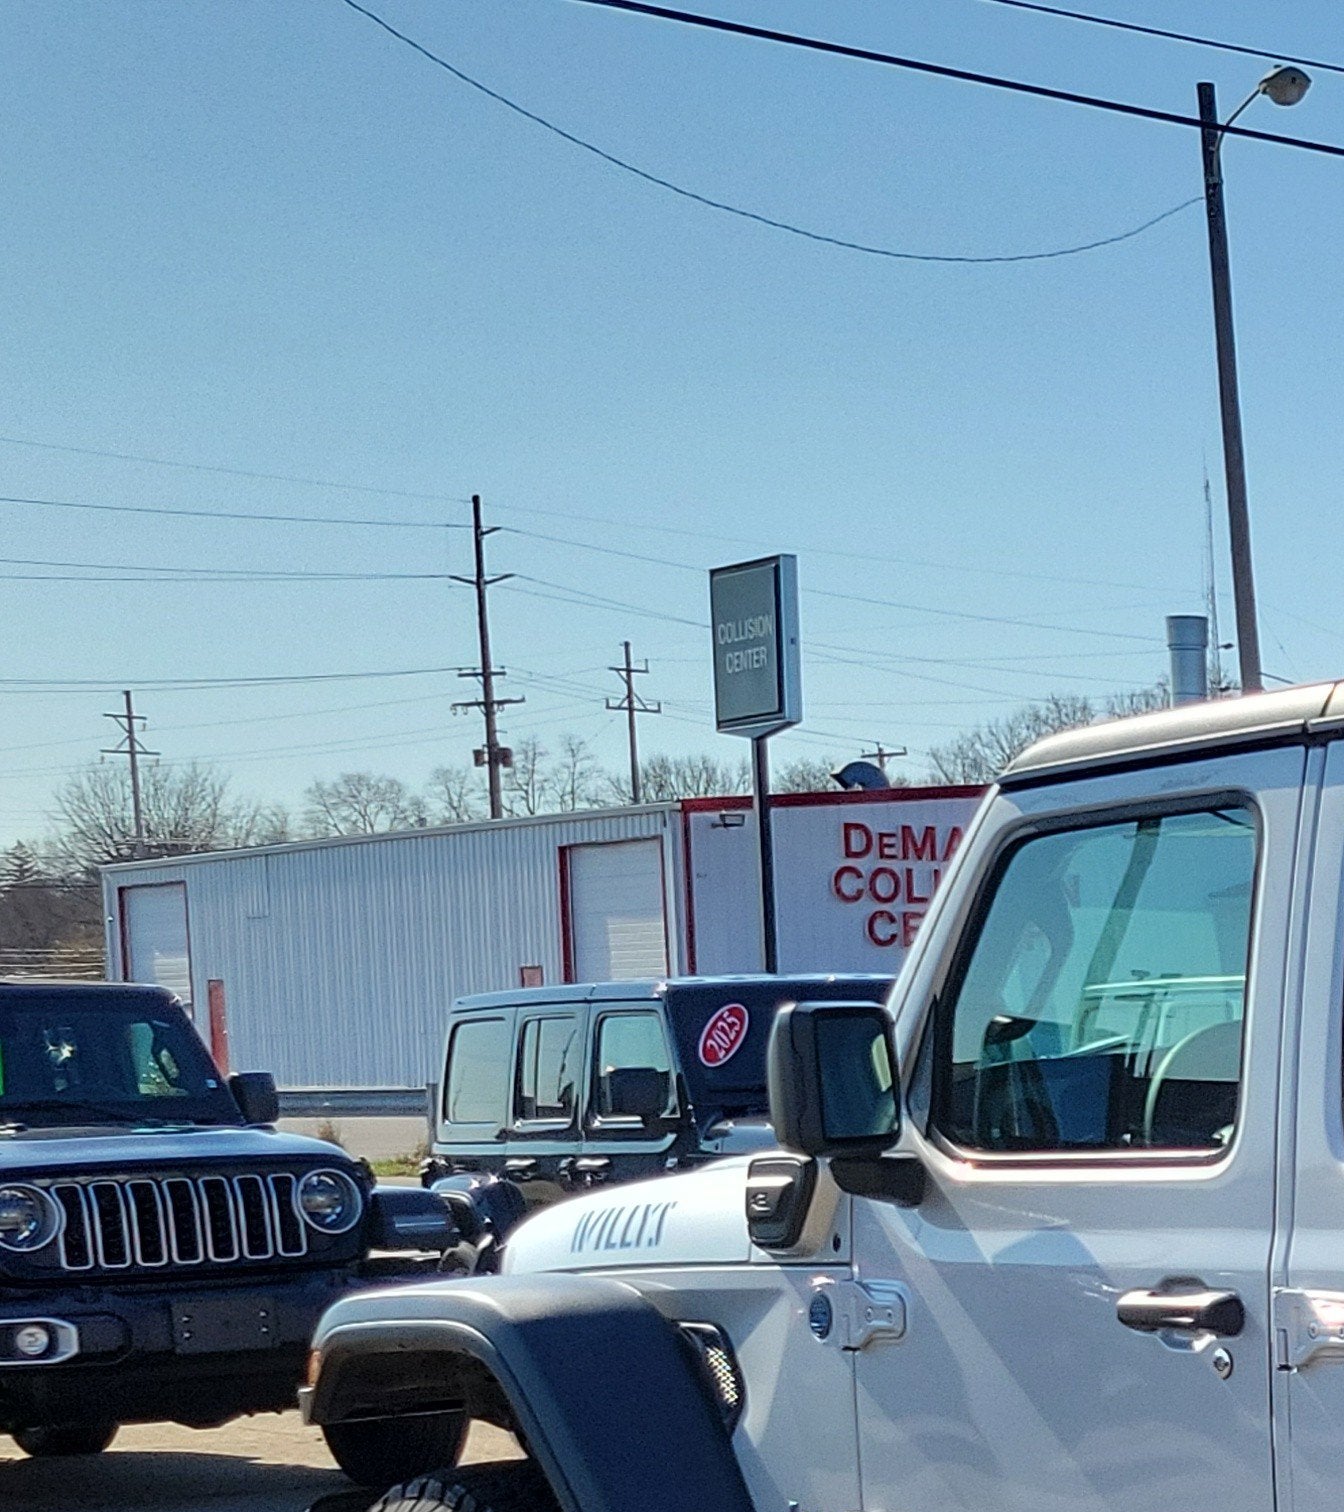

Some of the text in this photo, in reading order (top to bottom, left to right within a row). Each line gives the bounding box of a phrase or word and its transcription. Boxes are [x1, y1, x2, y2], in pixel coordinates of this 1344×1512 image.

[718, 614, 774, 645] COLLISION
[725, 646, 768, 674] CENTER
[706, 1010, 741, 1060] 2025
[570, 1200, 679, 1253] WILLYS
